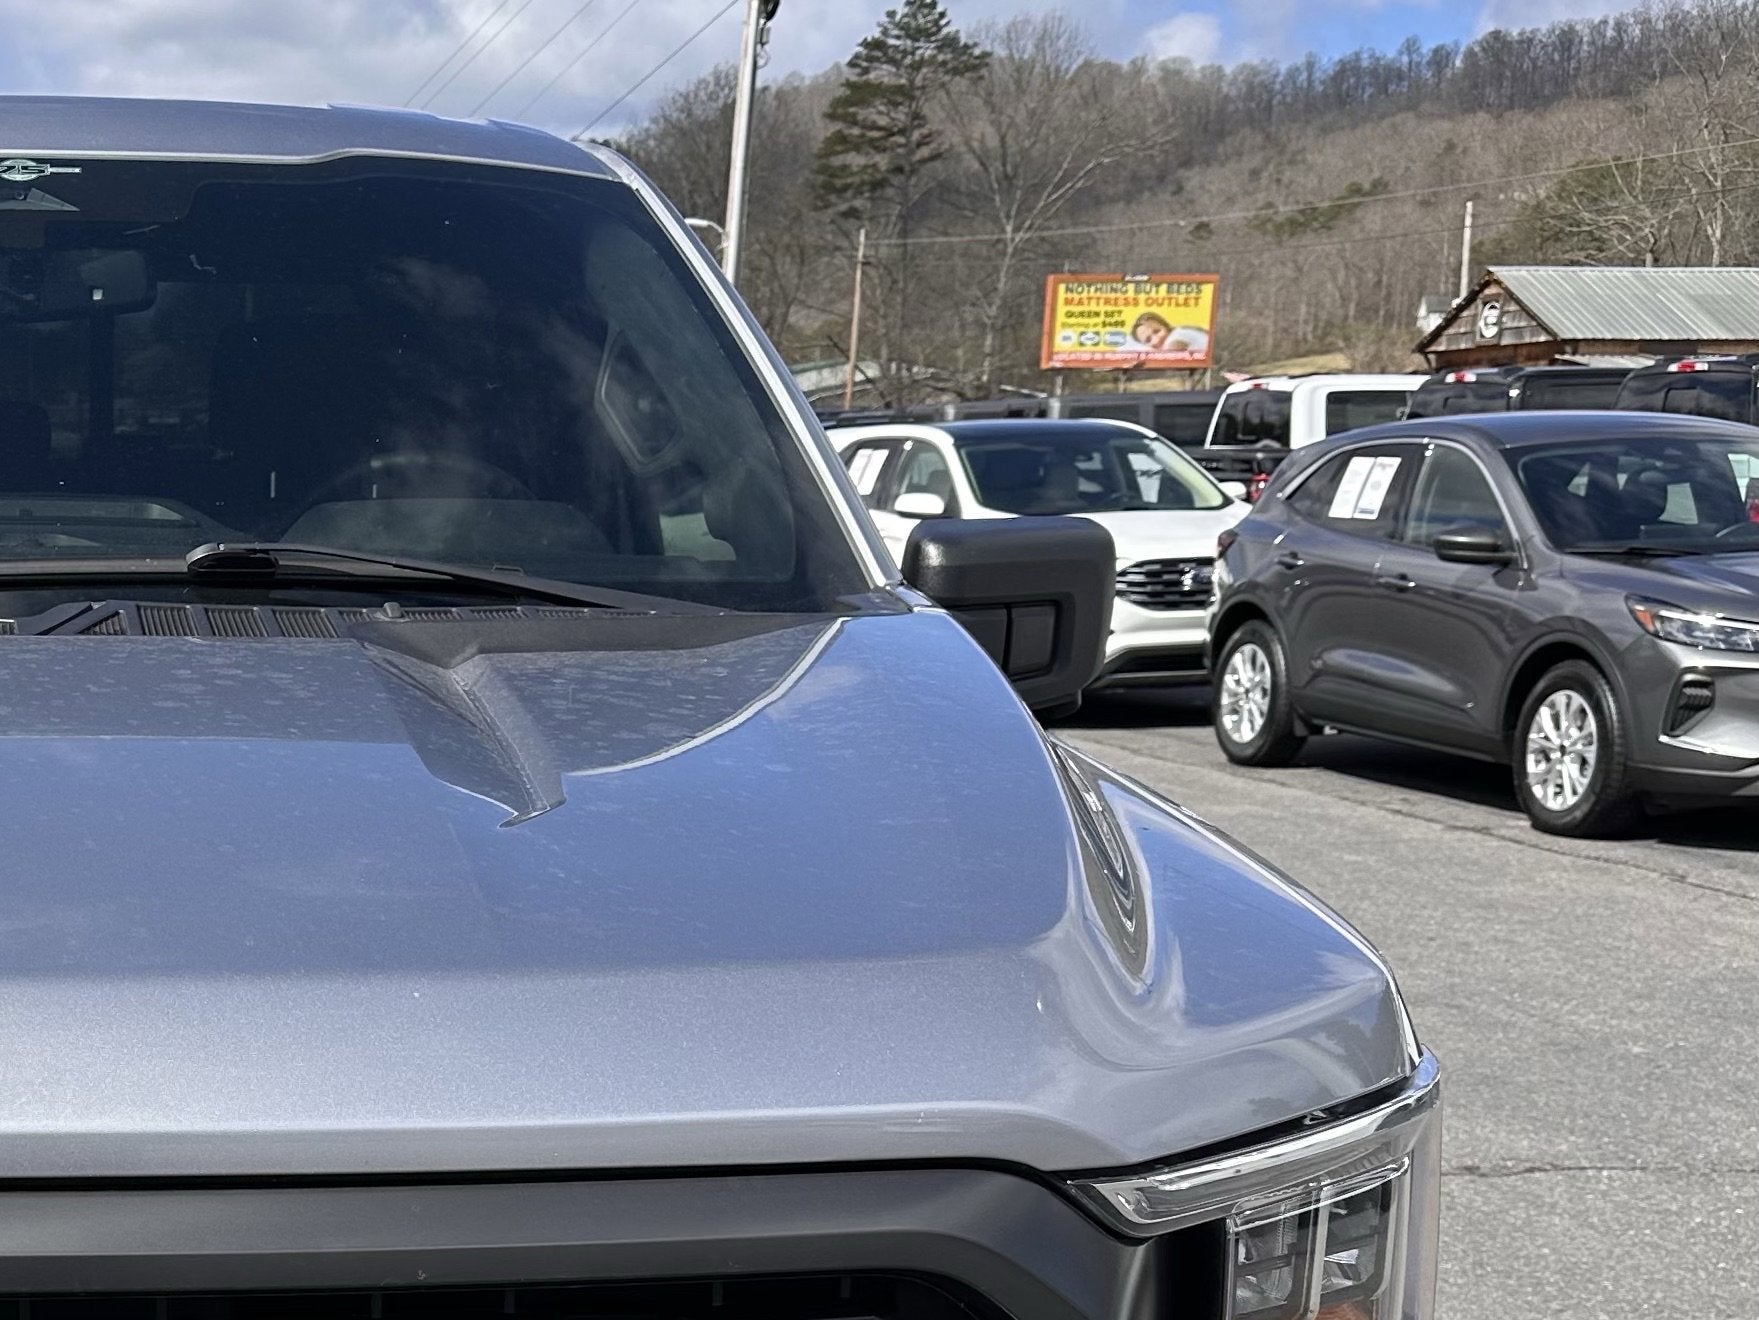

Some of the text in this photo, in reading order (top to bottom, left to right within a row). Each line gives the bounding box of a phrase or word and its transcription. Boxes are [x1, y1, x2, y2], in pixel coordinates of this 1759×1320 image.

[1065, 282, 1202, 294] NOTHING BUT BEDS
[1064, 296, 1200, 307] MATTRESS OUTLET
[1064, 309, 1123, 319] QUEEN SET
